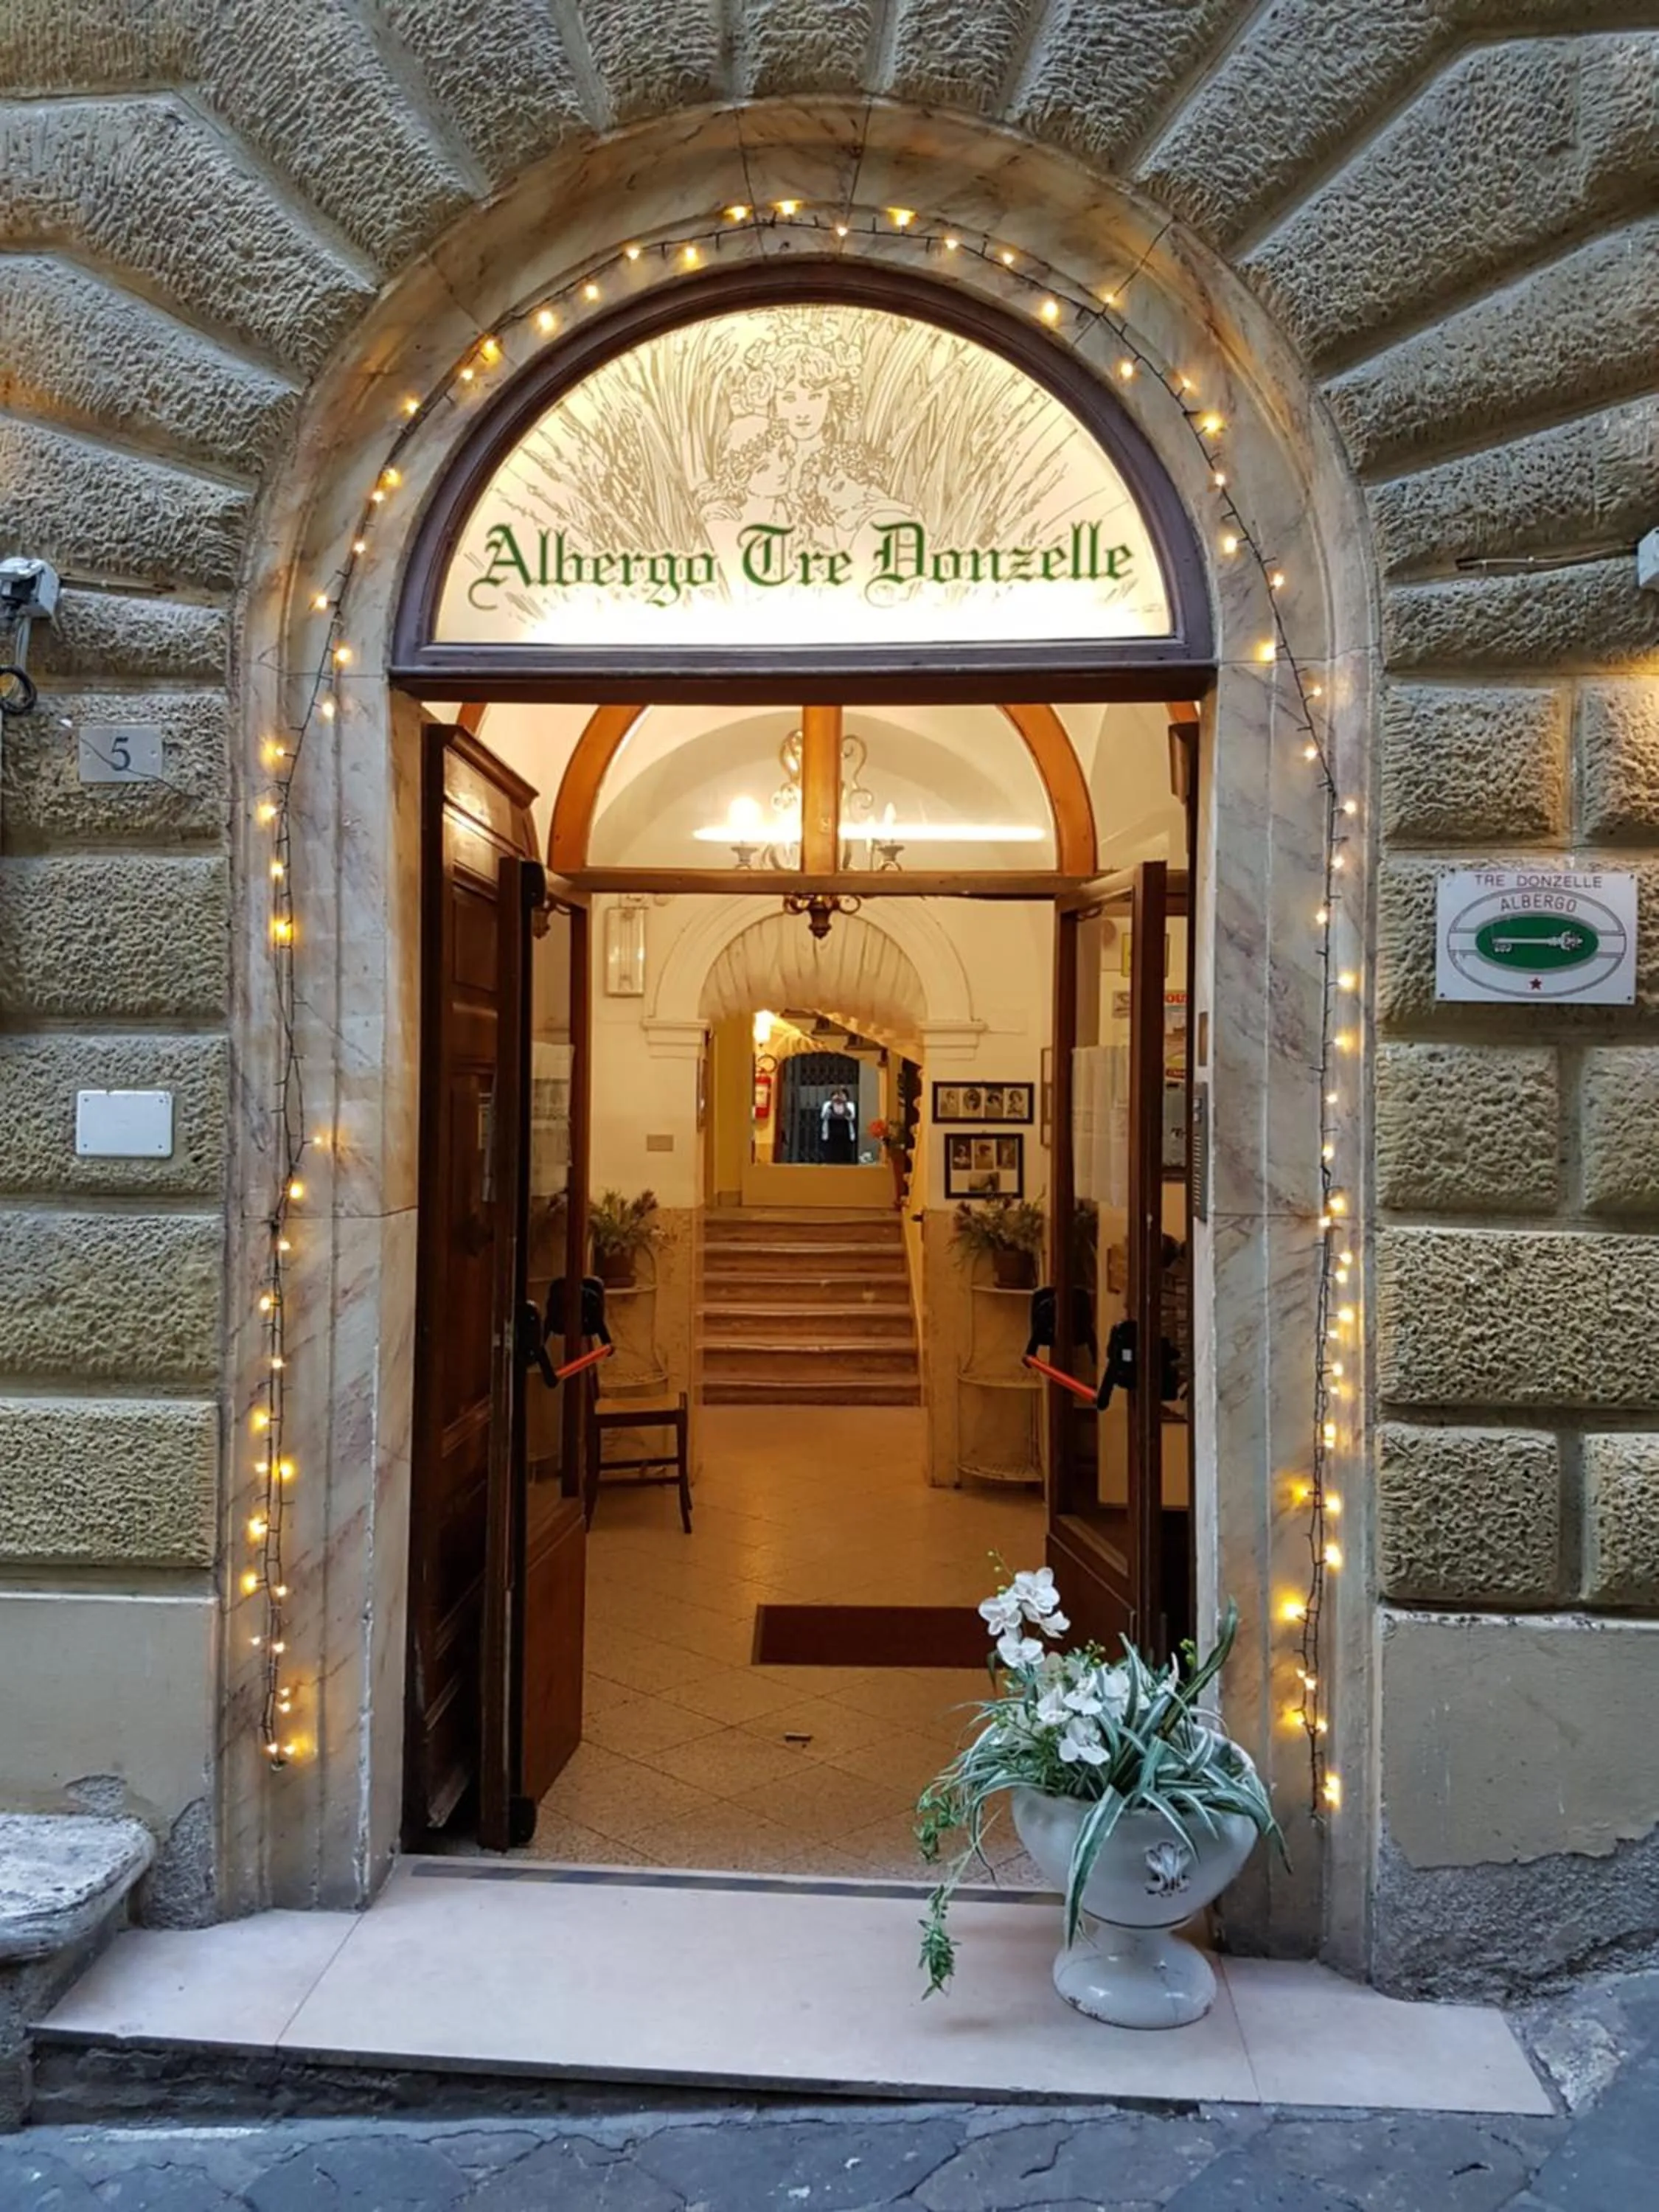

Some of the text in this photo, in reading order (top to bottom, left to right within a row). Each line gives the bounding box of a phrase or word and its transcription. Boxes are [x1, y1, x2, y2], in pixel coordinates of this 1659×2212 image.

[468, 518, 1134, 611] Albergo Tre Donzelle
[111, 737, 131, 771] 5
[1475, 874, 1603, 888] TRE DONZELLE
[1500, 894, 1578, 914] ALBERGO
